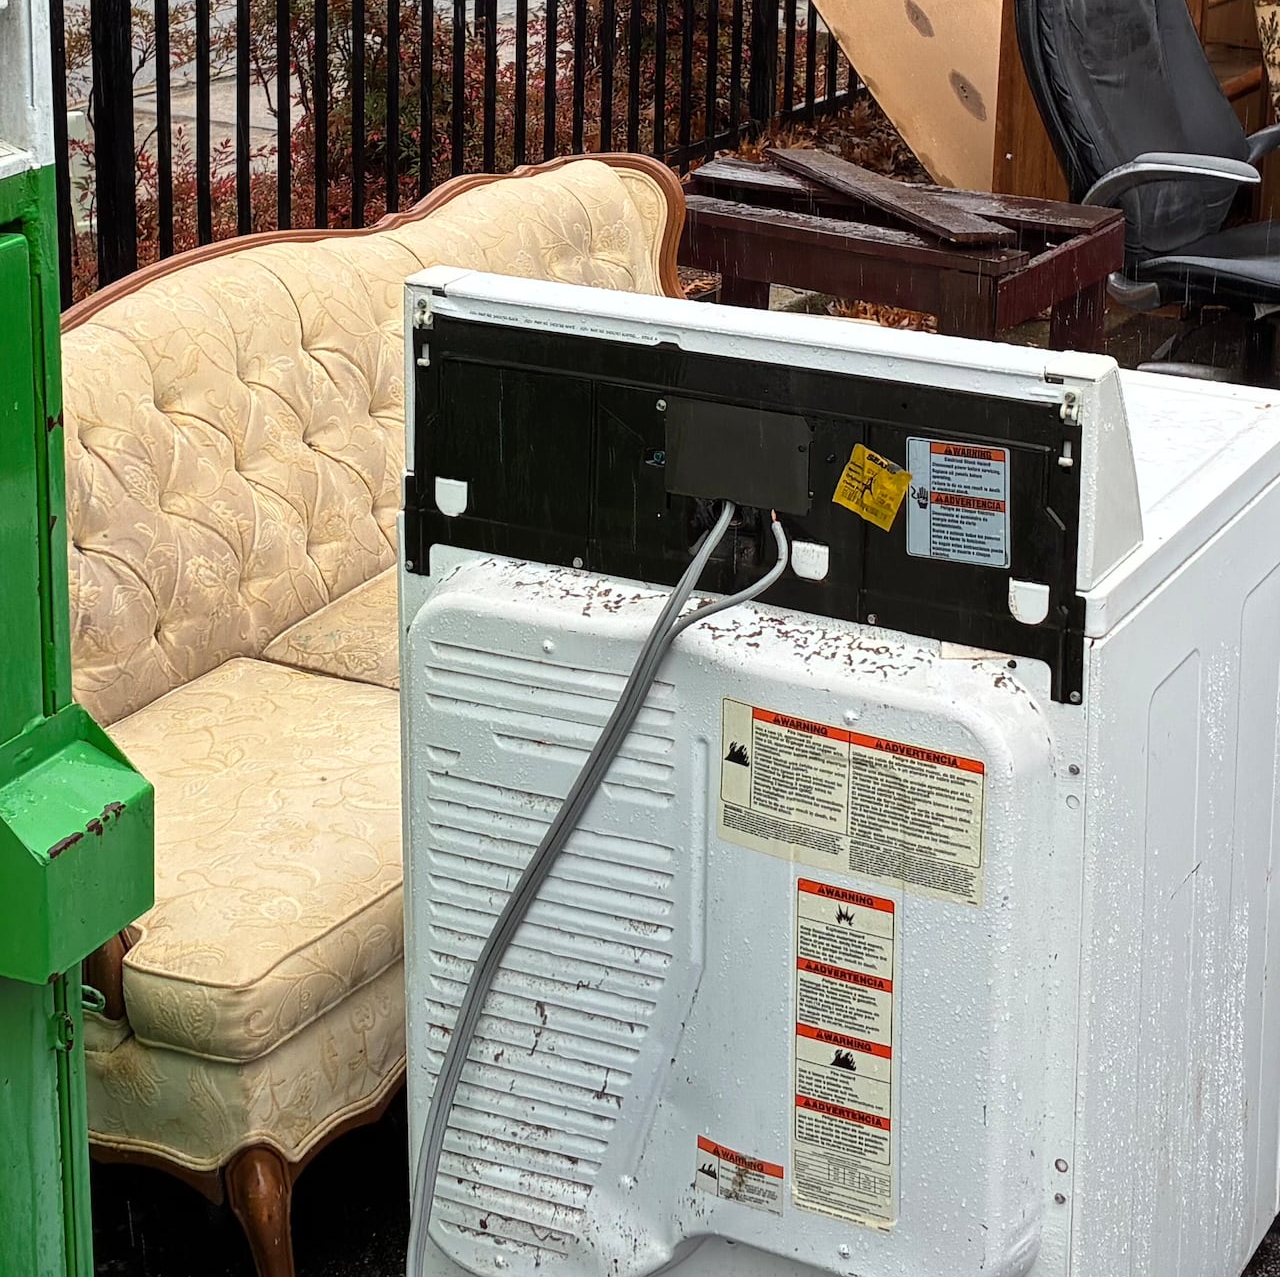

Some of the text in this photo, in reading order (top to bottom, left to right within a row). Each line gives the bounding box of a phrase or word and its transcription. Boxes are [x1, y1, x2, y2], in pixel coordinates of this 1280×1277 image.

[945, 493, 1001, 510] ADVERTENCIA
[780, 716, 828, 736] WARNING
[885, 742, 959, 767] ADVERTENCIA
[824, 887, 874, 907] WARNING
[814, 962, 884, 989] ADVERTENCIA
[824, 1032, 872, 1052] WARNING
[812, 1100, 883, 1127] ADVERTENCIA
